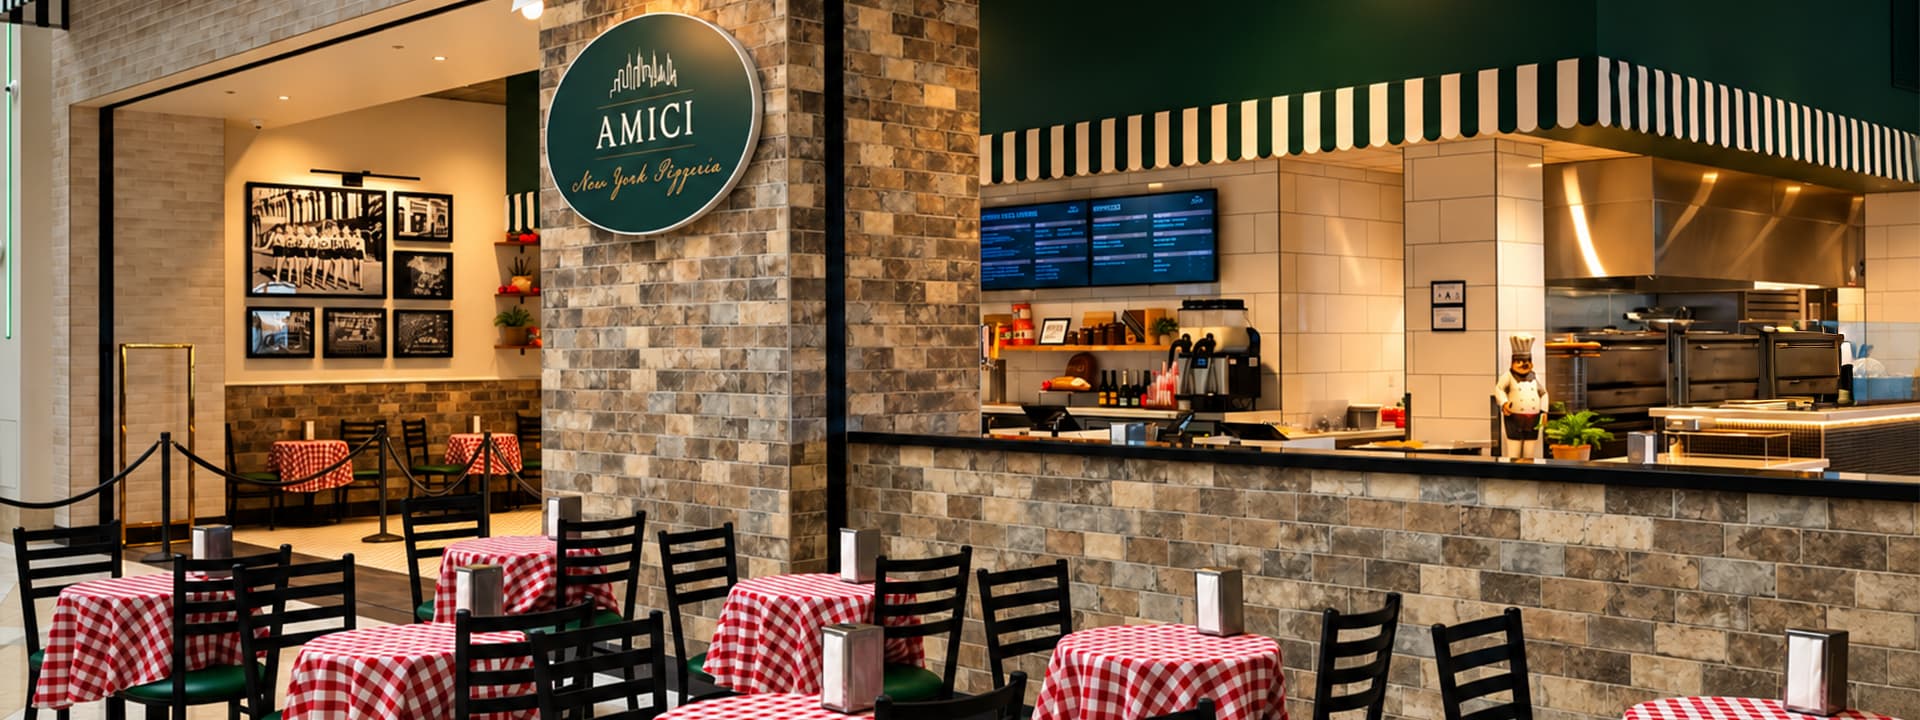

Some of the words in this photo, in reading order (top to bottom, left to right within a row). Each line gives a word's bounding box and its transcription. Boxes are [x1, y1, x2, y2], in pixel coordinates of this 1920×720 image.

[595, 100, 694, 150] AMICI
[610, 163, 648, 201] York
[653, 157, 722, 197] Pizzeria
